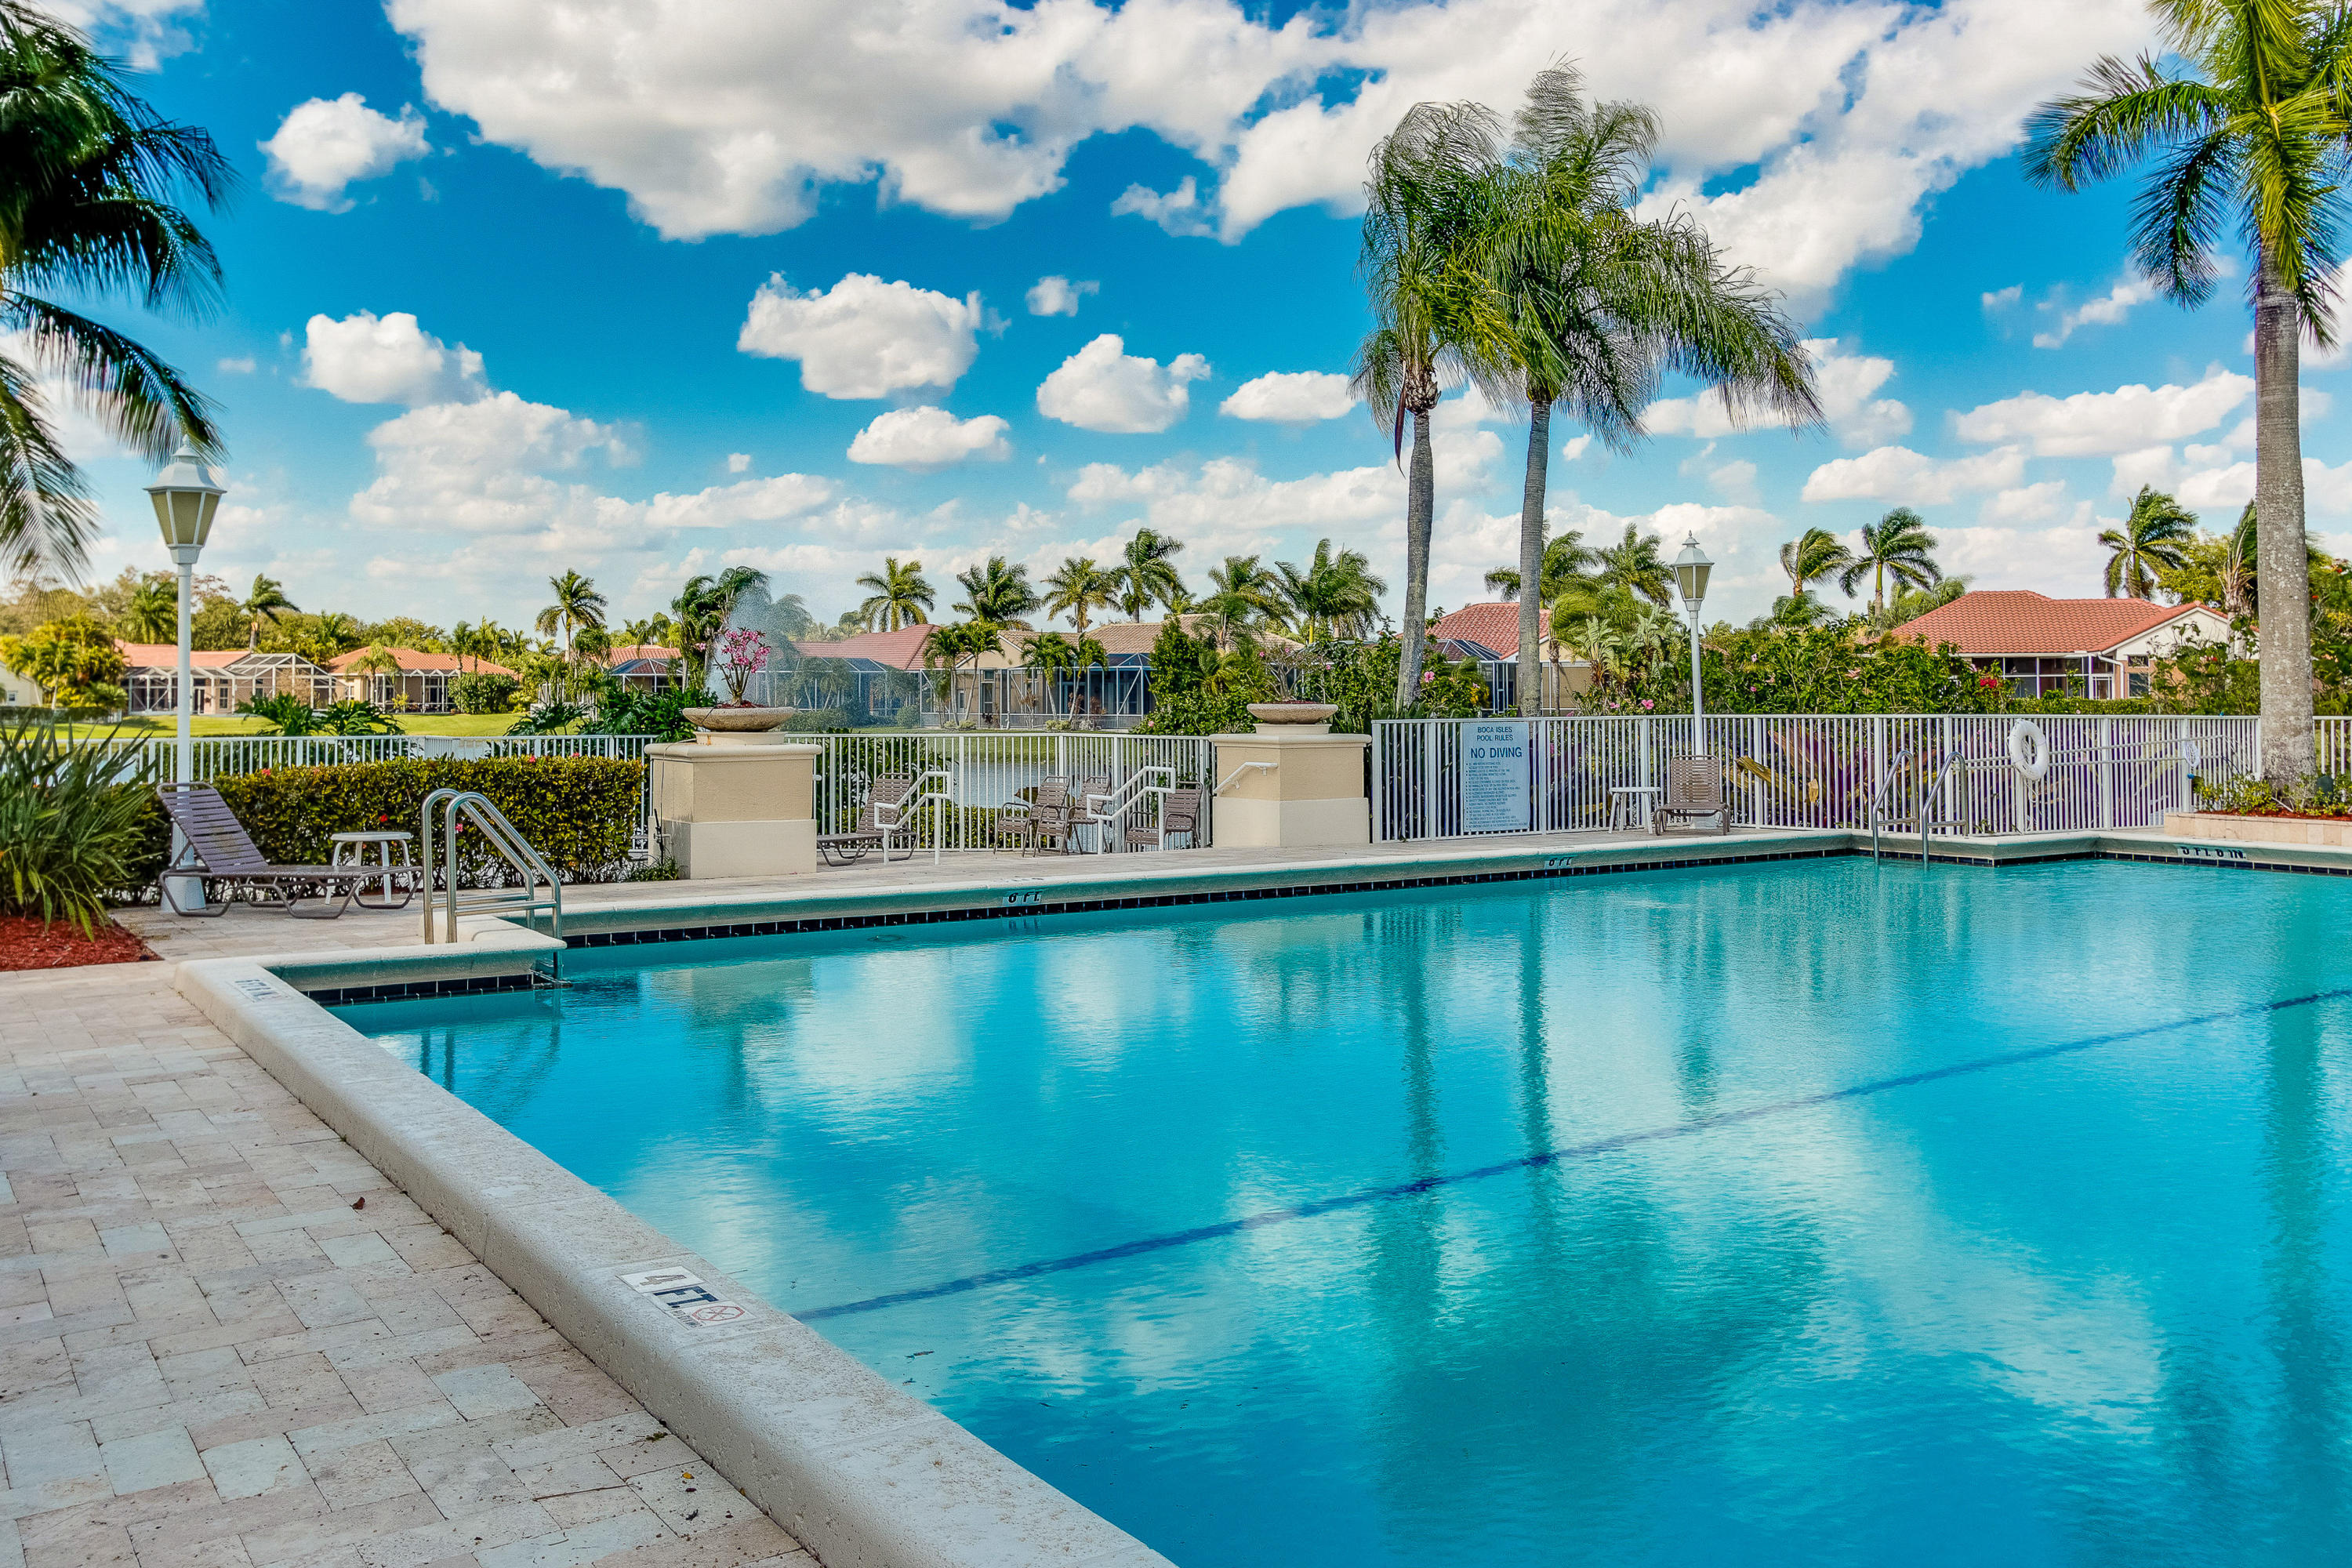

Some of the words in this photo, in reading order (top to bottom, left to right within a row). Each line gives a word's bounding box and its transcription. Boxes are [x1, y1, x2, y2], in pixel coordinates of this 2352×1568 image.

[1470, 747, 1486, 759] NO
[1490, 746, 1523, 758] DIVING
[1008, 891, 1018, 903] 6
[1022, 891, 1044, 902] FT.
[640, 1274, 687, 1287] 4
[653, 1286, 720, 1308] FT.
